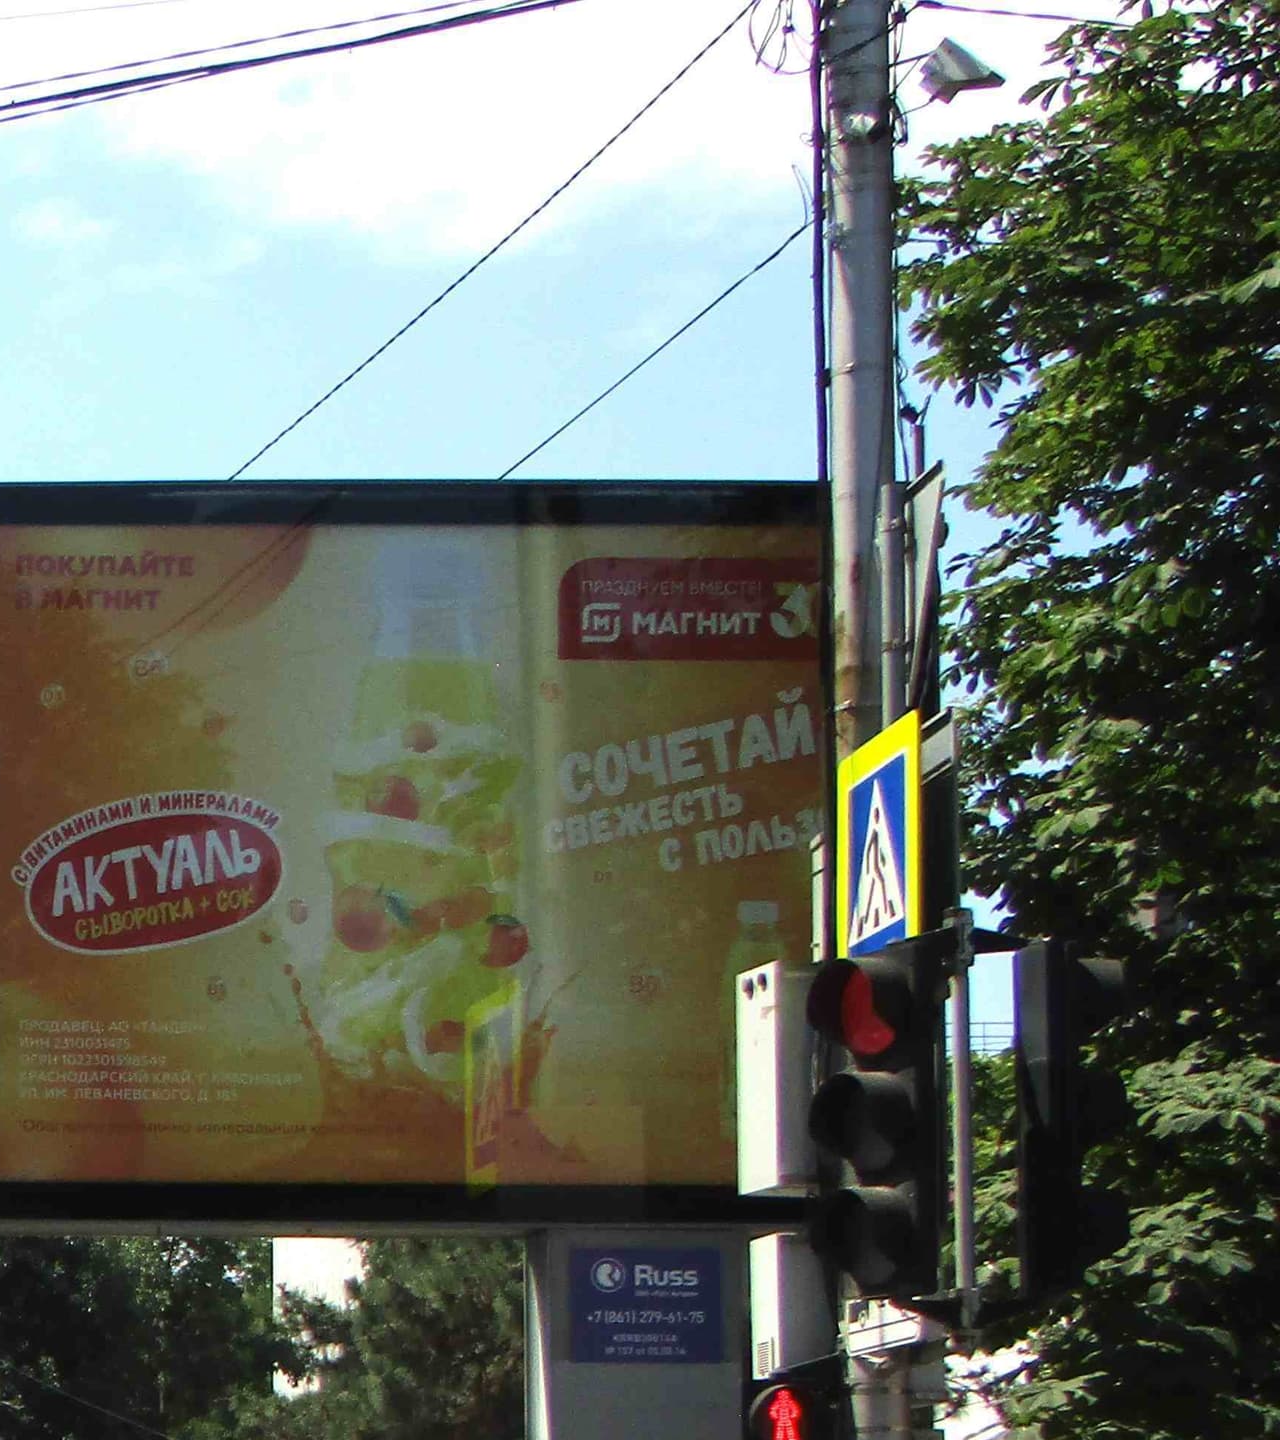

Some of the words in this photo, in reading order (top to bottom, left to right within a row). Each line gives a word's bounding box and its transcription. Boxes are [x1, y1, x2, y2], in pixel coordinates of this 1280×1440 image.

[16, 551, 195, 577] ПОКУПАЙТЕ
[16, 589, 32, 610] В
[40, 589, 161, 610] МАГНИТ
[632, 611, 761, 636] МАГНИТ
[560, 687, 816, 804] СОЧЕТАЙ
[25, 799, 134, 869] ВИТАМИНАМИ
[140, 796, 151, 814] И
[158, 792, 281, 829] МИНЕРАЛАМИ
[543, 783, 744, 853] СВЕЖЕСТЬ
[658, 837, 683, 872] С
[51, 829, 262, 917] АКТУАЛЬ
[75, 901, 195, 941] СЫВОРОТКА
[215, 885, 256, 913] СОК
[19, 1070, 150, 1085] КРАСНОДАРСКИЙ
[633, 1264, 700, 1287] Russ
